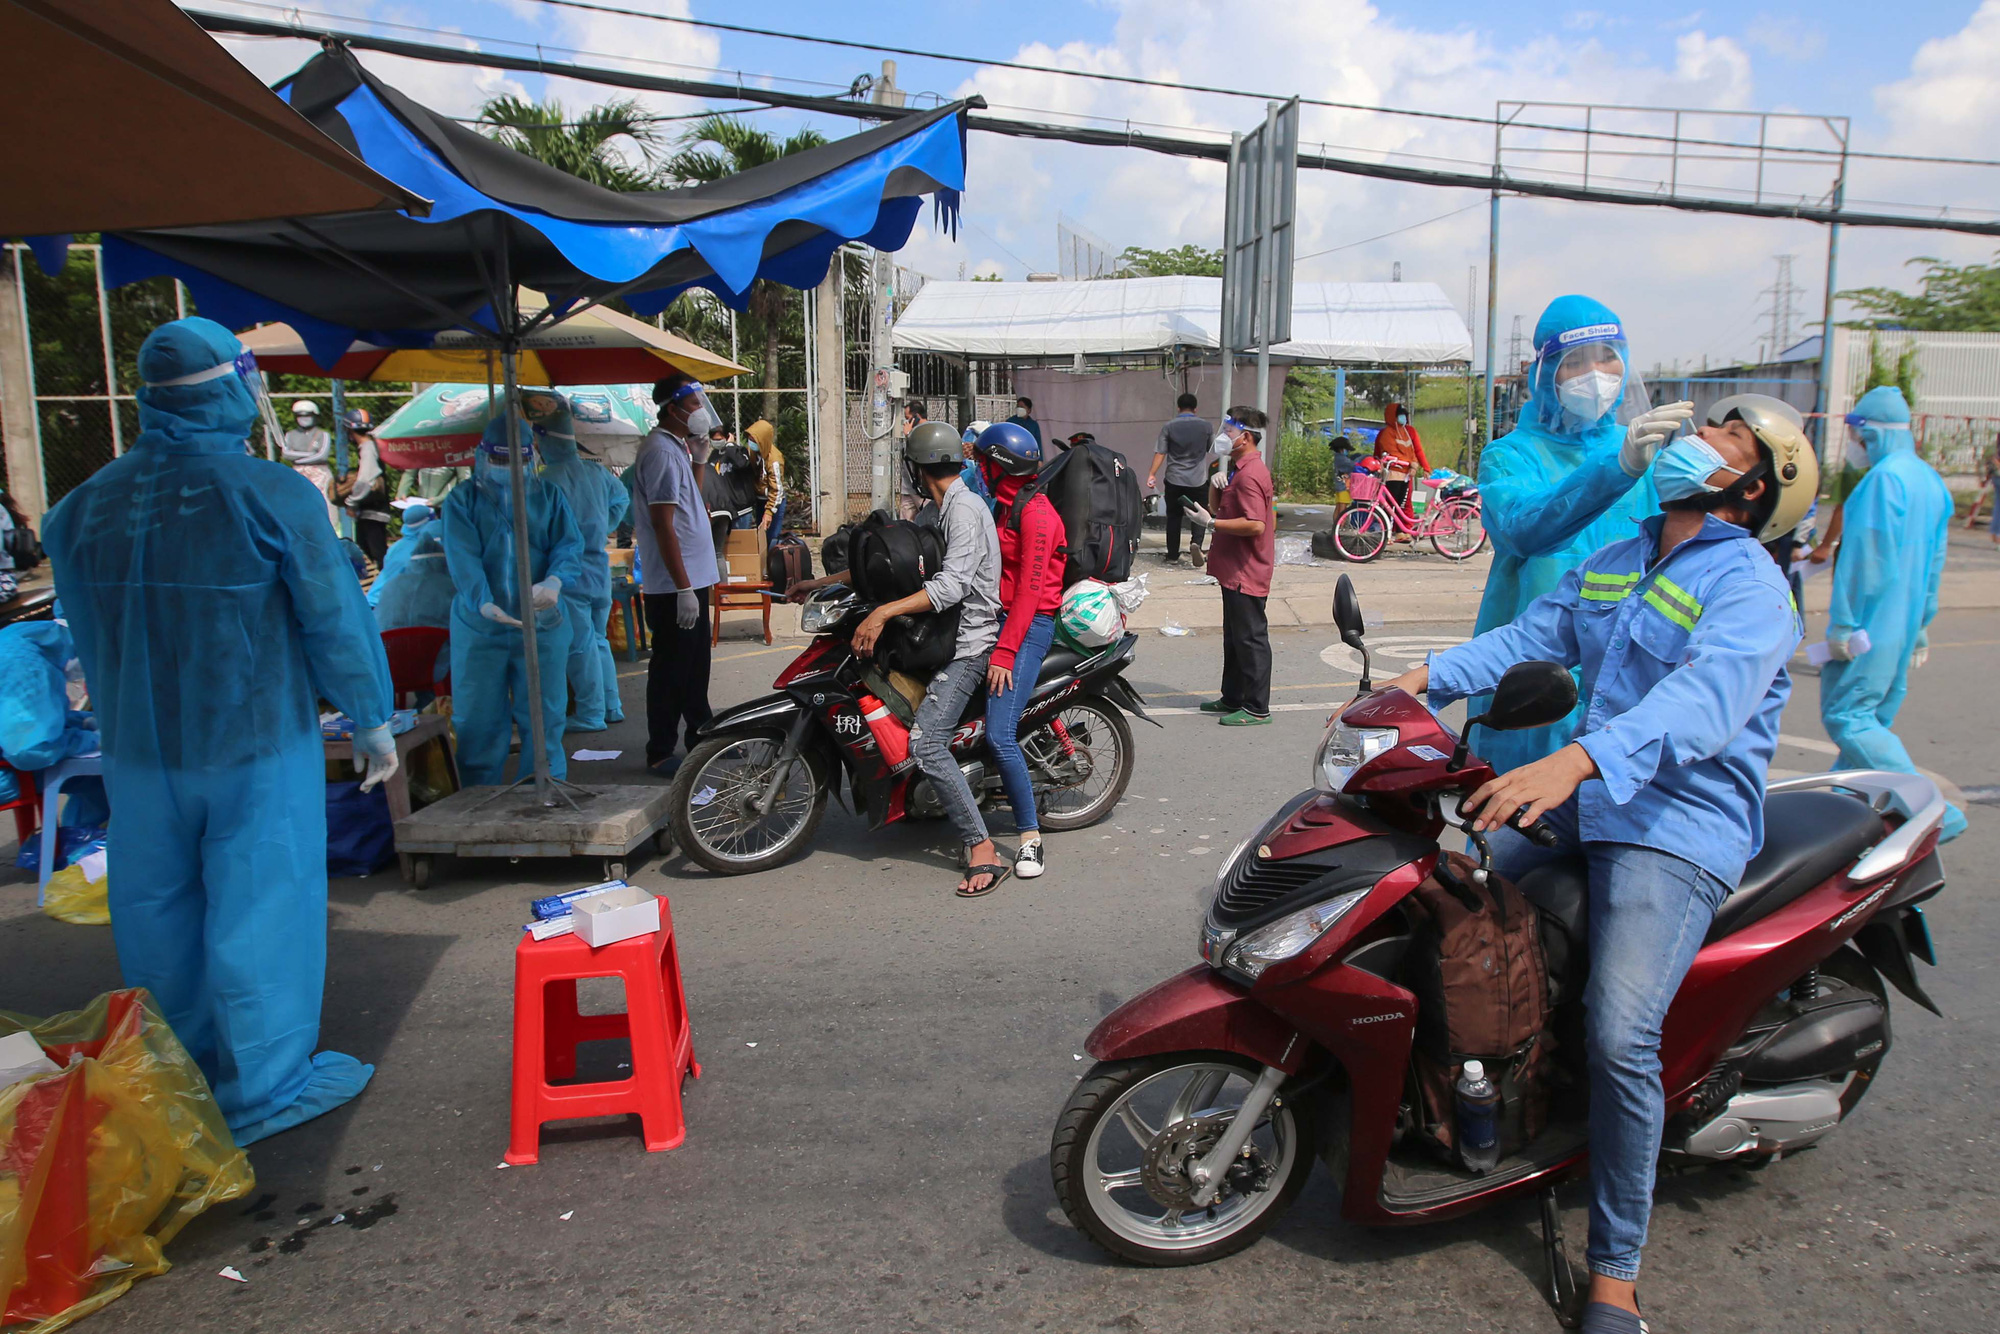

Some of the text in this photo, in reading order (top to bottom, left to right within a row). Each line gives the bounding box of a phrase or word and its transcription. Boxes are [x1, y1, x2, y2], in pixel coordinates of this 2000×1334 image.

[550, 334, 596, 343] COFFEE
[1563, 331, 1585, 341] Face
[1587, 326, 1616, 336] Shield
[1034, 519, 1047, 553] CLASS
[1029, 555, 1044, 592] WORLD
[890, 755, 915, 773] YAMAH
[1352, 1011, 1406, 1025] HONDA
